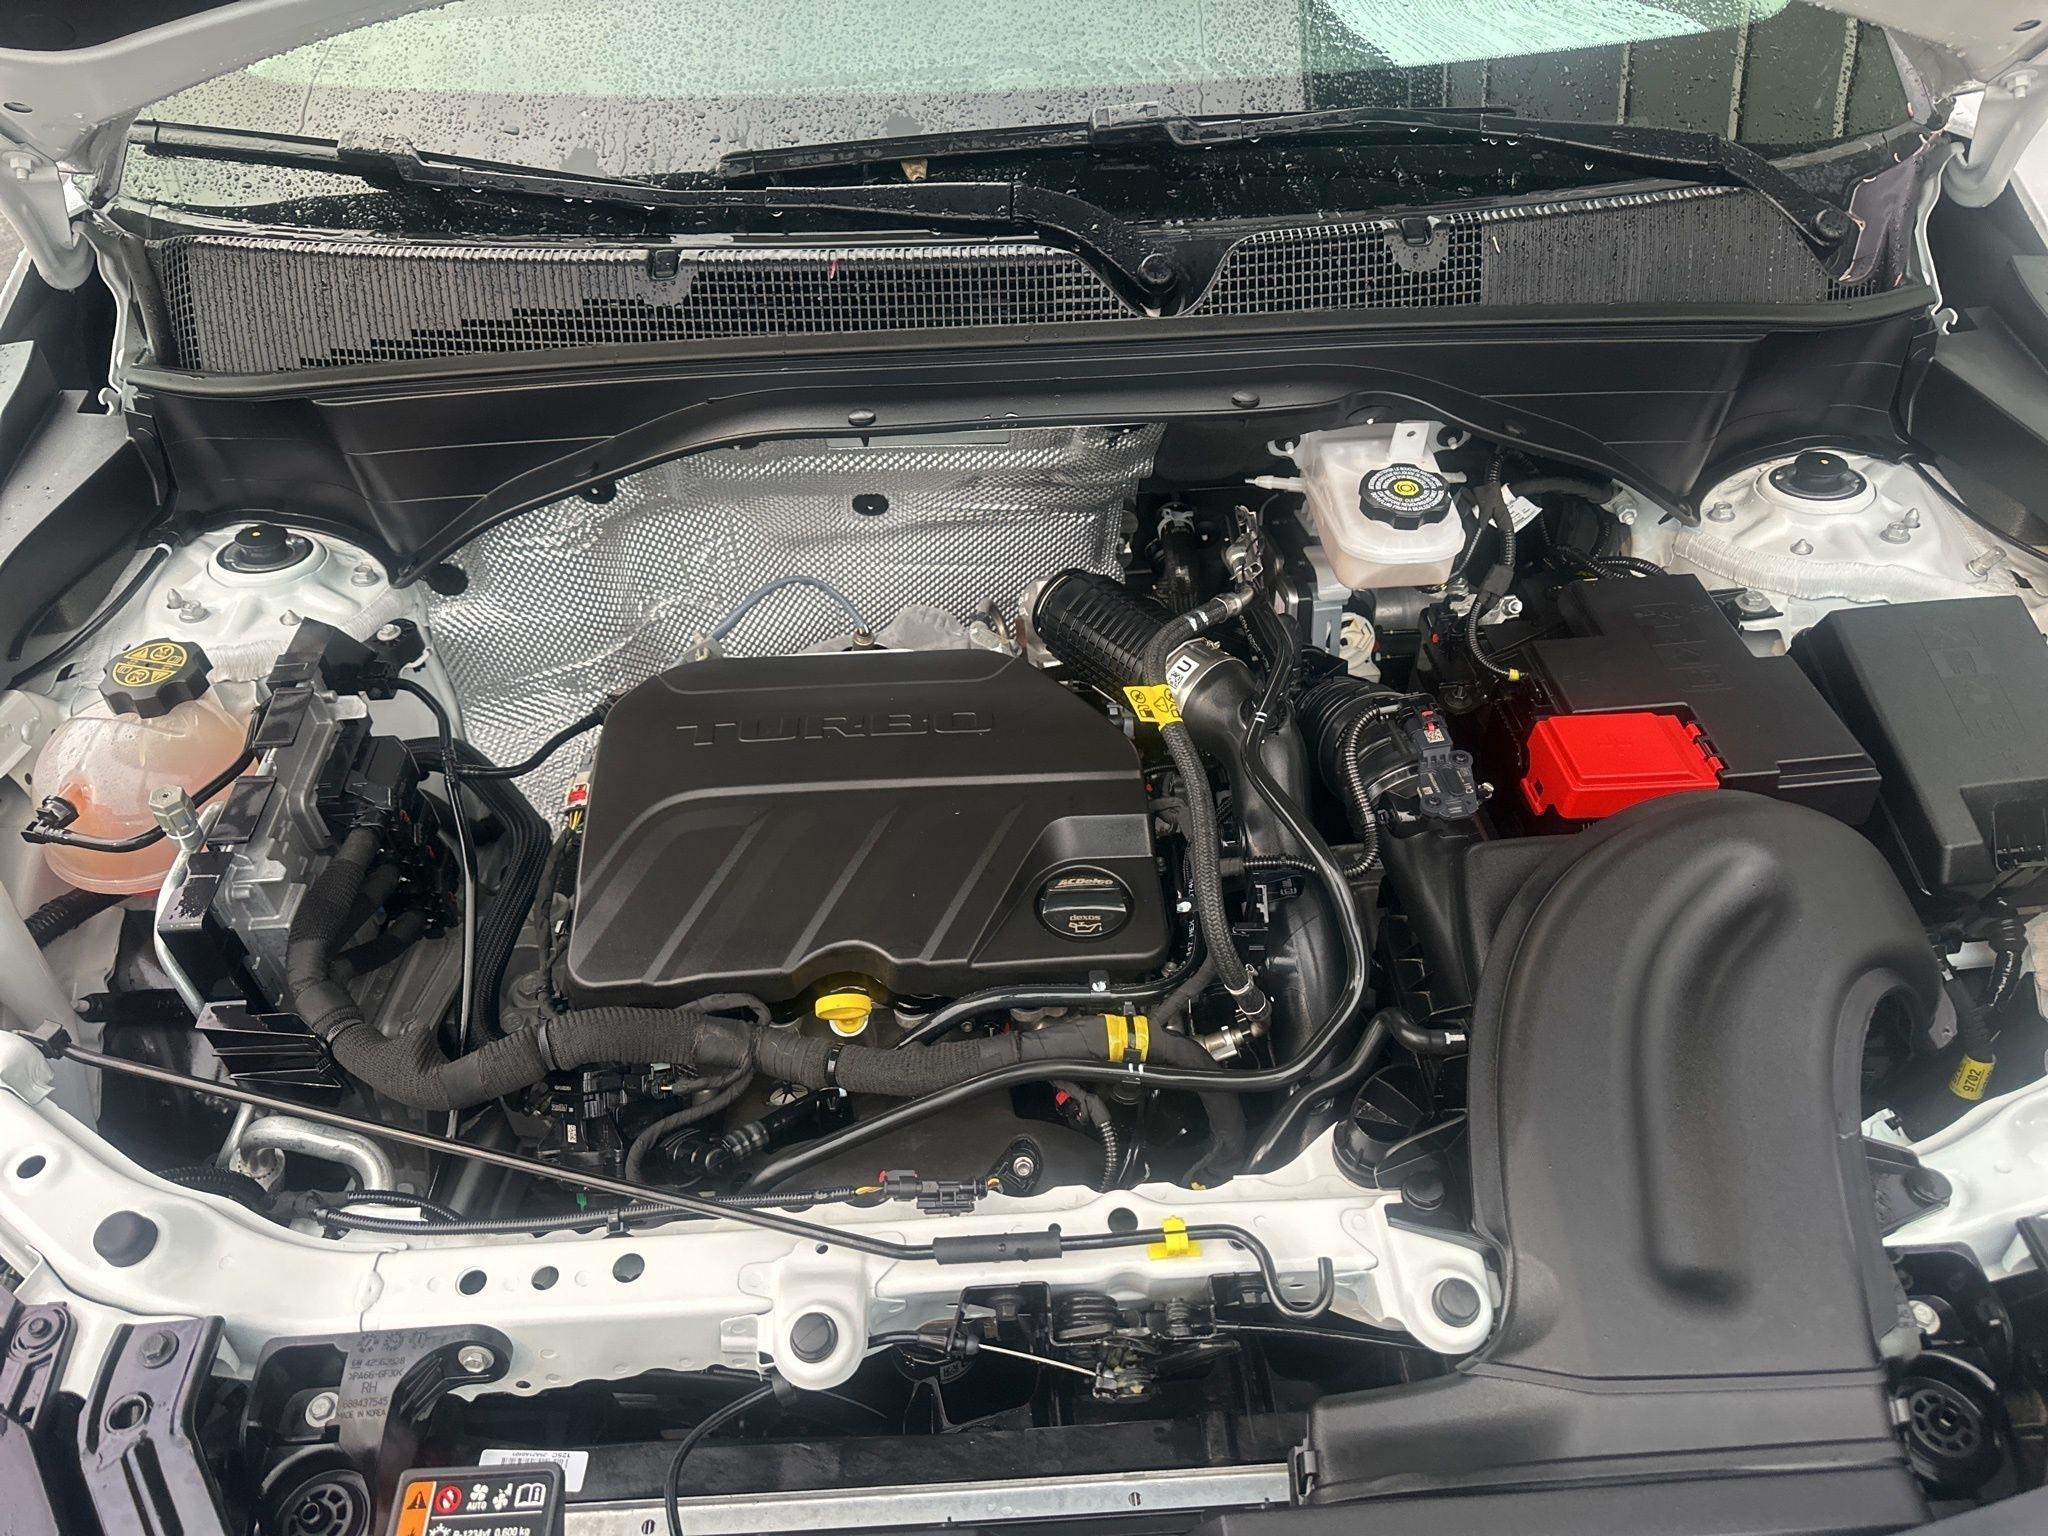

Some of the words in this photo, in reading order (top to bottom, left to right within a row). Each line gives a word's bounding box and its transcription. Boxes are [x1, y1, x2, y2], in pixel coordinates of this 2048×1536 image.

[1177, 660, 1191, 672] U
[675, 711, 993, 746] TURBO
[1054, 878, 1114, 888] ACDelco
[1963, 1068, 1982, 1092] 9702
[362, 1381, 378, 1394] RH
[366, 1408, 386, 1417] KOREA
[466, 1501, 488, 1511] AUTO
[494, 1527, 518, 1536] 0.600
[519, 1526, 531, 1536] kg
